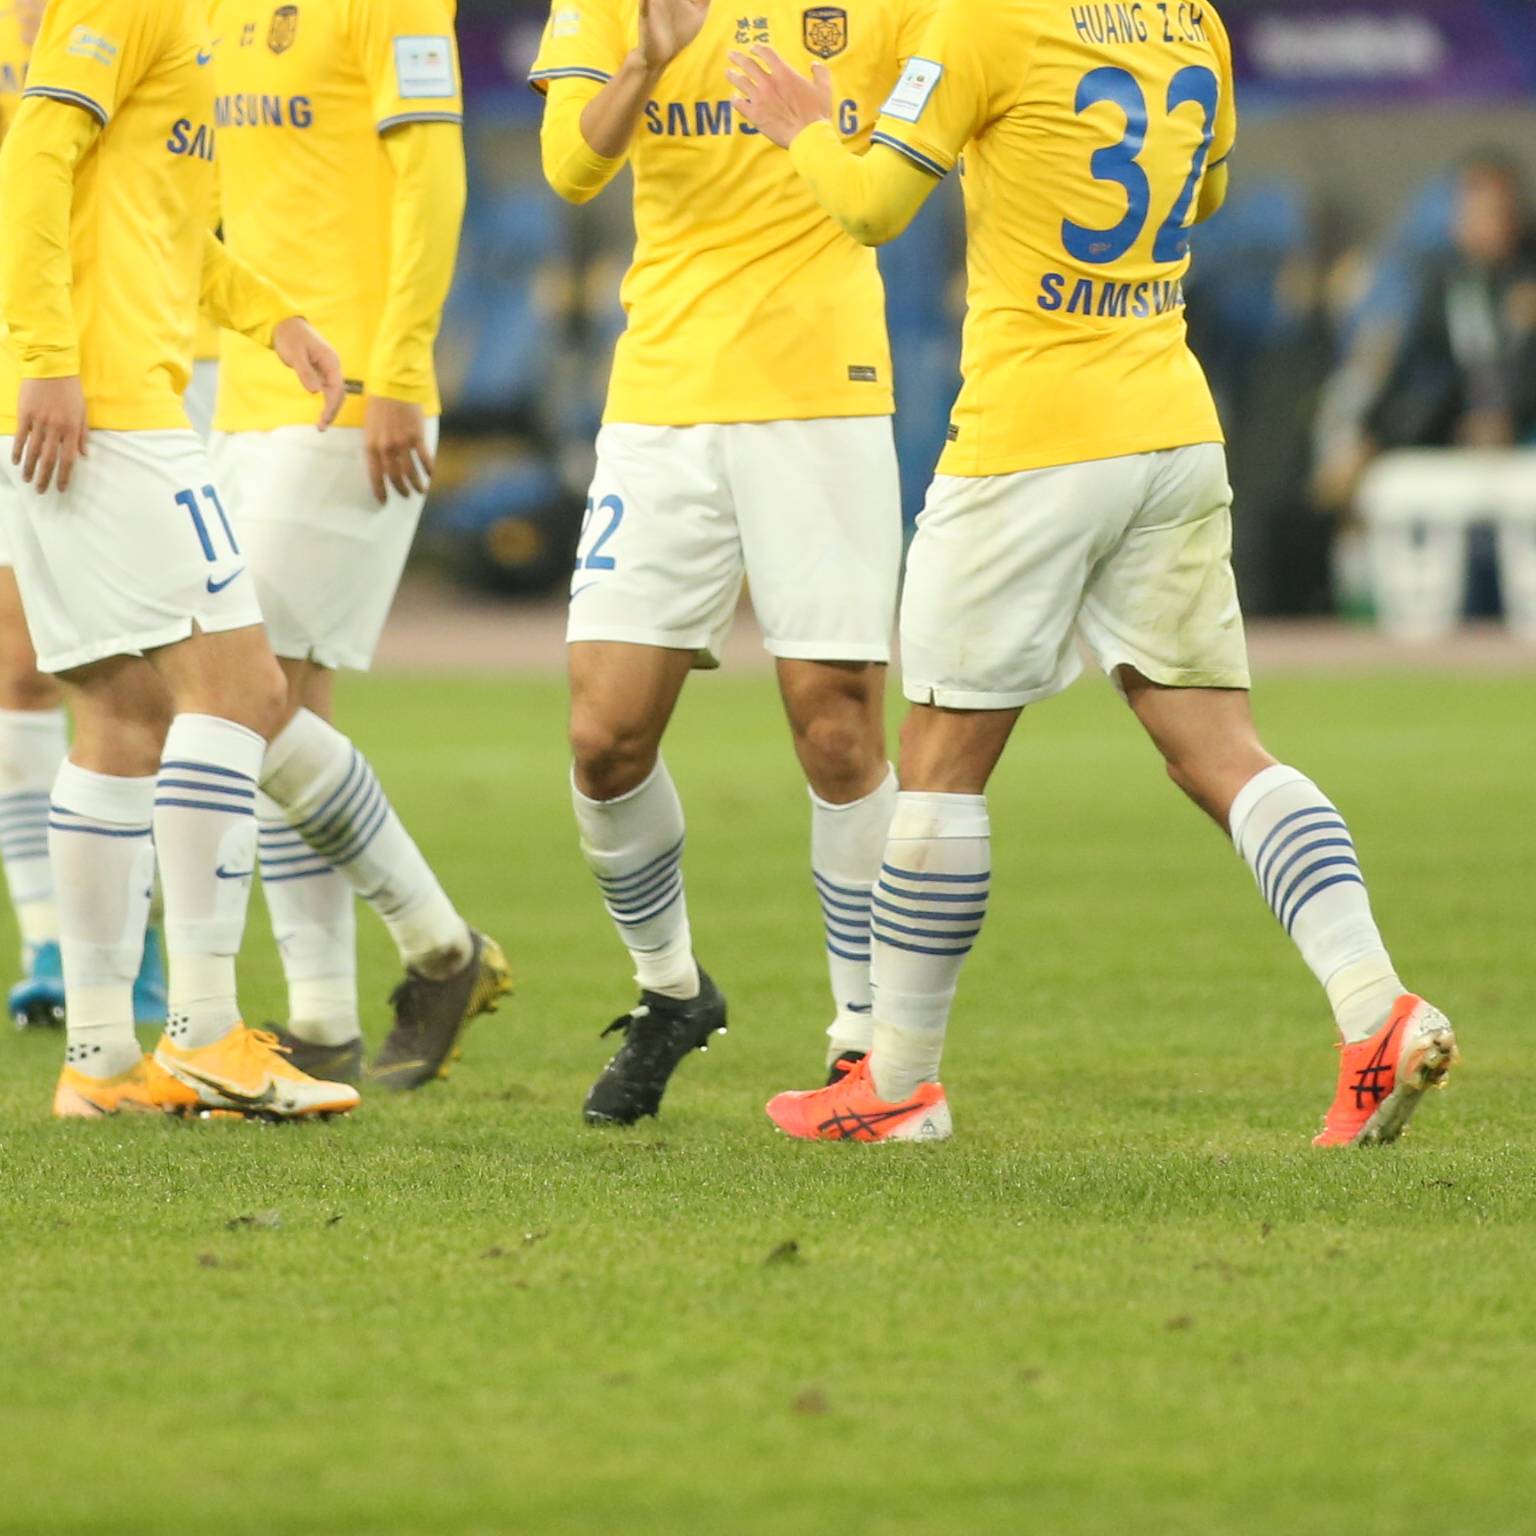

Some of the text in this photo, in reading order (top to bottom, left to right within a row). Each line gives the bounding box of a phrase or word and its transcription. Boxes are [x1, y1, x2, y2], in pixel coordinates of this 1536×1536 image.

[1070, 2, 1148, 44] HUANG
[644, 99, 859, 136] SAMG
[1061, 65, 1219, 264] 32
[174, 483, 240, 562] 11
